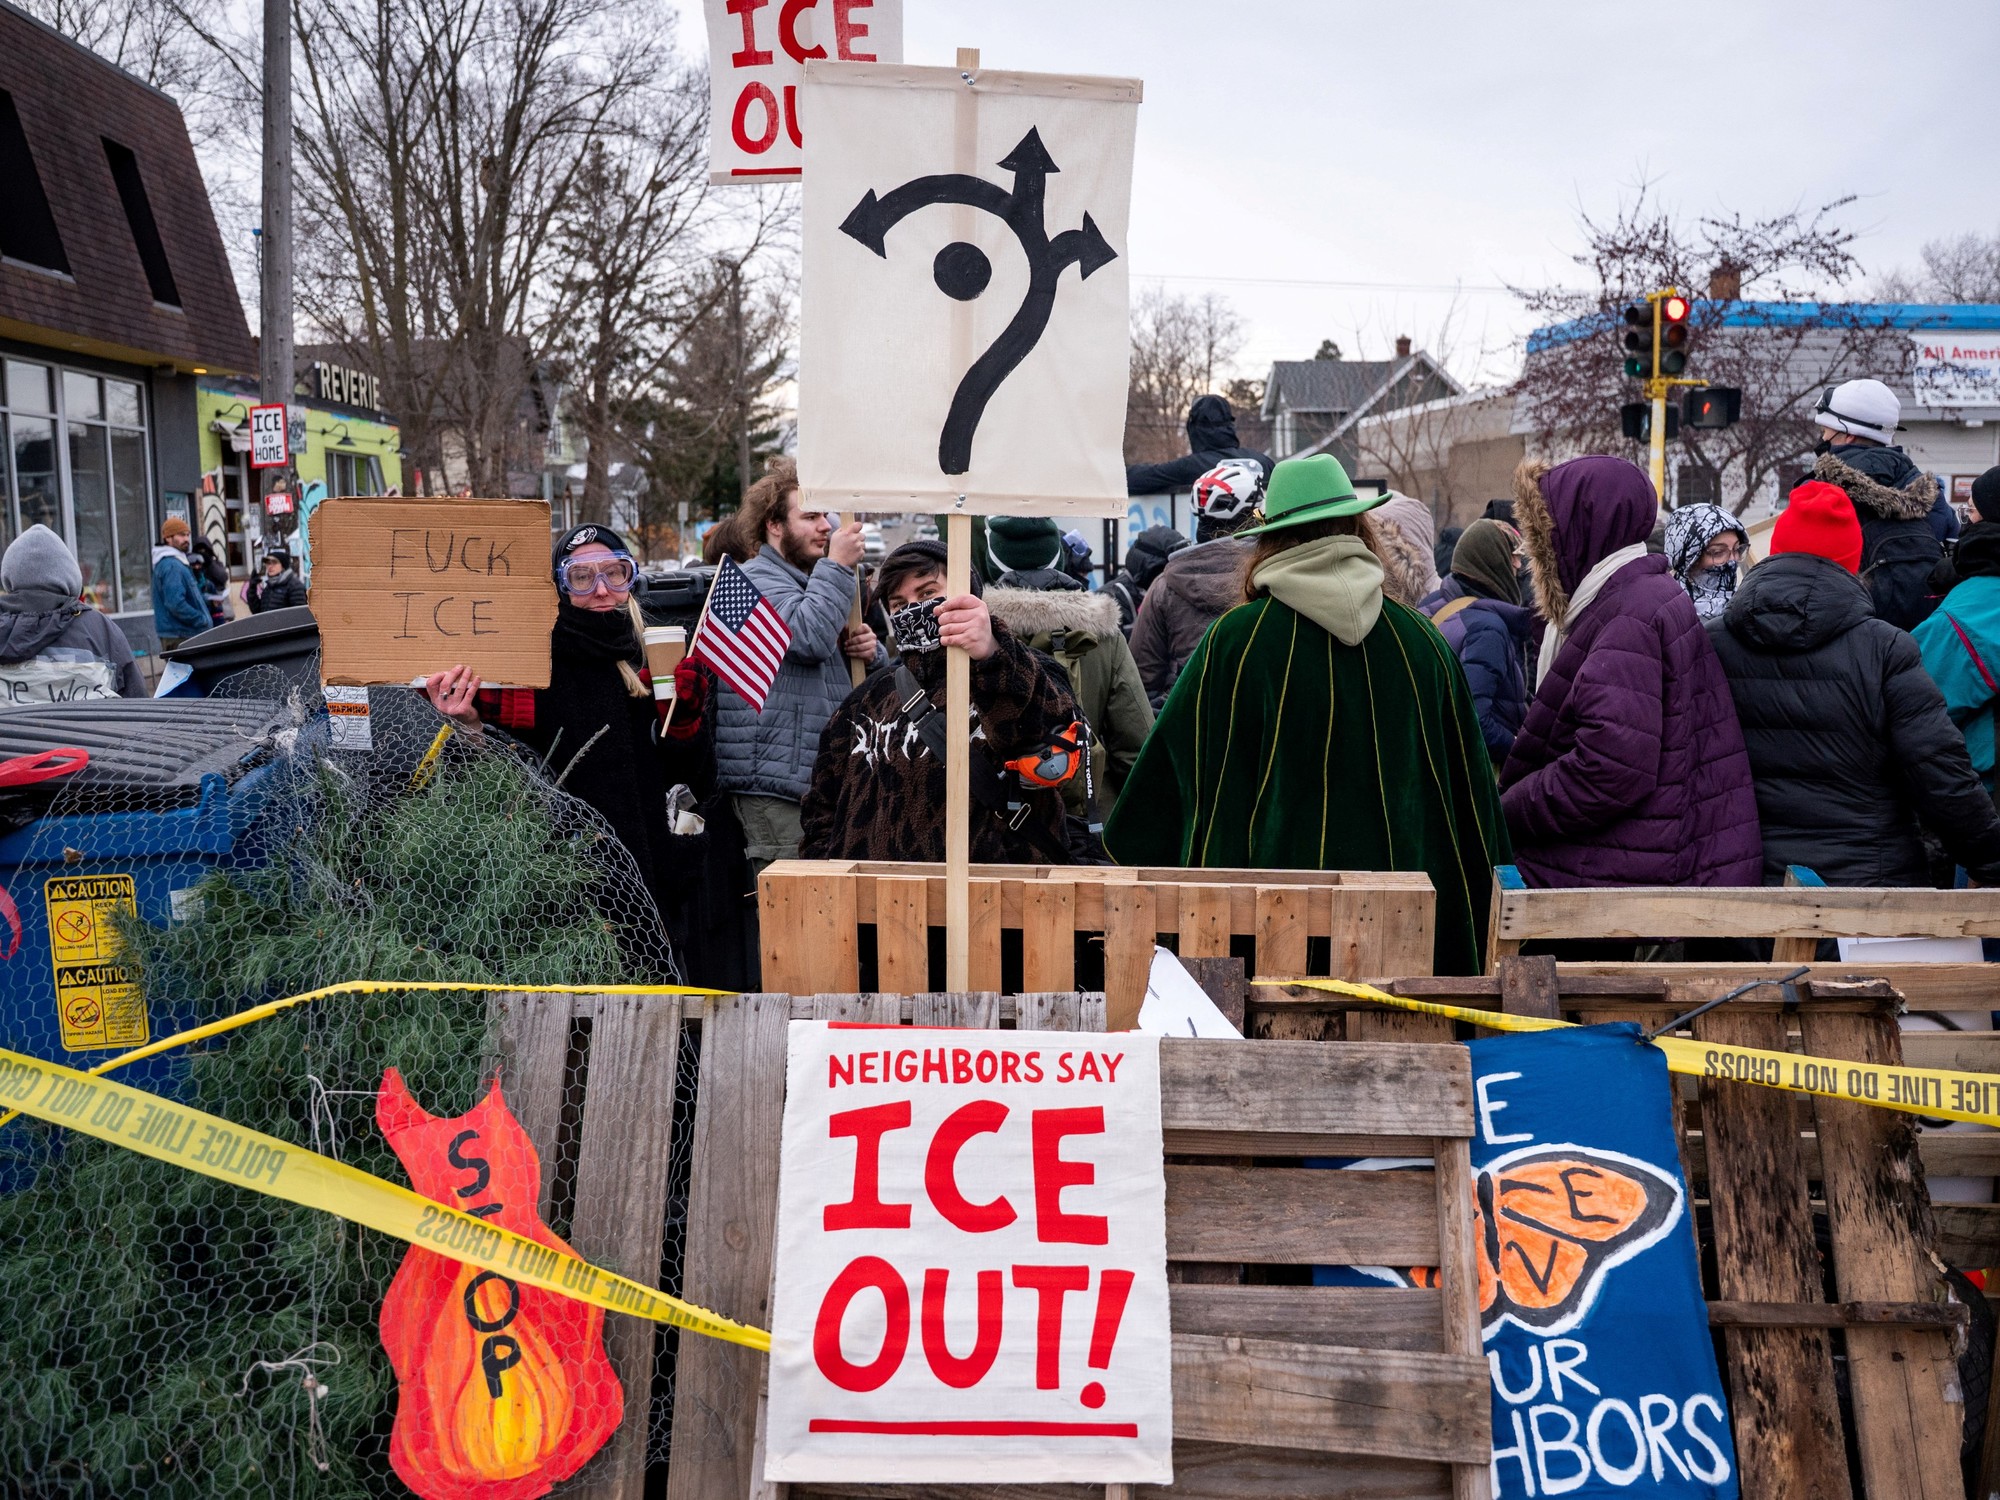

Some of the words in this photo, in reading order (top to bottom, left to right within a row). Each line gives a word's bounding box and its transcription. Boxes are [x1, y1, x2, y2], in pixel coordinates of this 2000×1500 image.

[725, 0, 877, 68] ICE
[1924, 346, 1945, 360] All
[319, 361, 380, 411] REVERIE
[254, 413, 282, 433] ICE
[262, 436, 274, 444] GO
[255, 445, 284, 461] HOME
[390, 529, 516, 578] FUCK
[392, 591, 499, 638] ICE
[67, 880, 130, 898] CAUTION
[828, 1047, 1044, 1089] NEIGHBORS
[1057, 1051, 1124, 1083] SAY
[1704, 1050, 1780, 1086] CROSS
[1790, 1062, 1838, 1093] NOT
[1847, 1069, 1878, 1100] DO
[1888, 1074, 1942, 1108] LINE
[823, 1099, 1109, 1246] ICE
[447, 1129, 522, 1399] SOP
[813, 1255, 1135, 1409] OUT!
[1486, 1338, 1600, 1404] UR
[1491, 1393, 1731, 1500] HBORS
